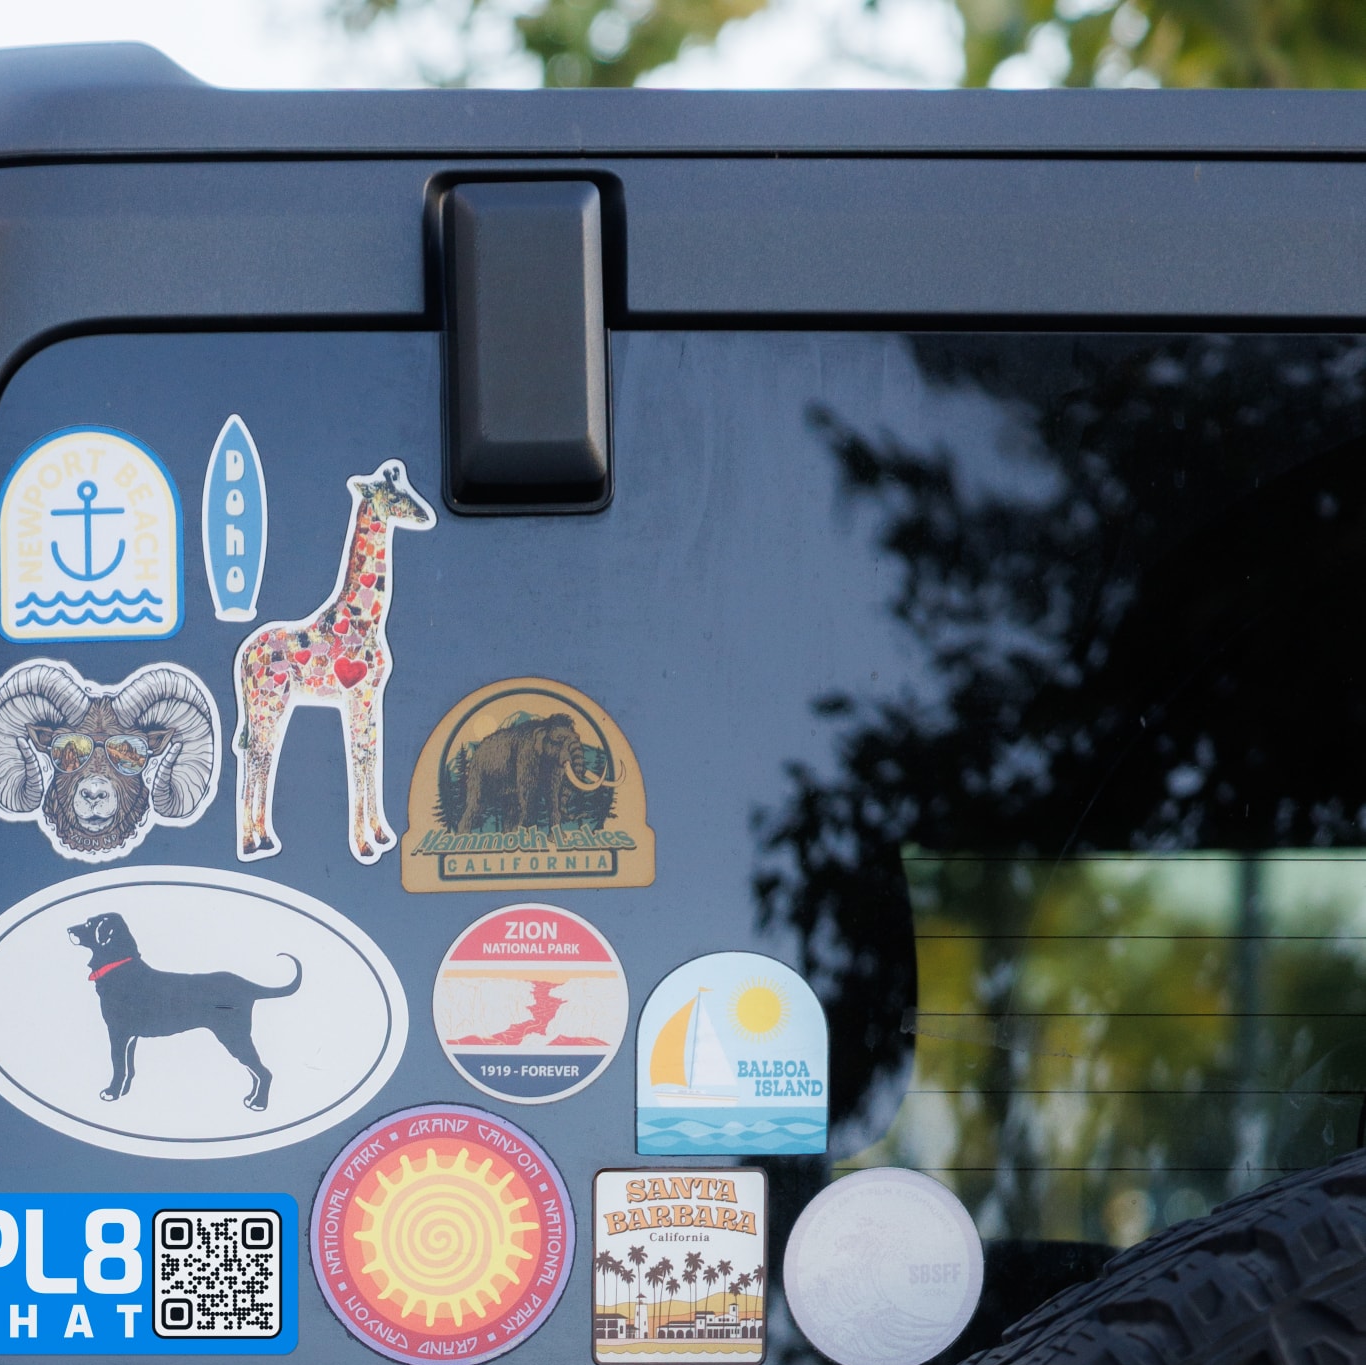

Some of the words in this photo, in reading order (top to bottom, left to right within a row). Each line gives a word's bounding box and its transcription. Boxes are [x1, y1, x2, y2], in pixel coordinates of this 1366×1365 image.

[18, 448, 107, 583] NEWPORT
[113, 461, 160, 582] BEACH
[70, 833, 100, 847] ZION
[411, 824, 550, 856] Mammoth
[551, 823, 637, 851] Lakes
[447, 854, 609, 873] CALIFORNIA
[504, 921, 558, 940] ZION
[482, 943, 545, 954] NATIONAL
[548, 943, 580, 955] PARK
[480, 1065, 512, 1077] 1919
[521, 1065, 580, 1077] FOREVER
[737, 1060, 810, 1078] BALBOA
[755, 1079, 824, 1097] ISLAND
[408, 1118, 470, 1138] GRAND
[478, 1124, 542, 1179] CANYON
[625, 1176, 739, 1204] SANTA
[324, 1186, 349, 1276] NATIONAL
[343, 1139, 385, 1181] PARK
[603, 1204, 758, 1236] BARBARA
[536, 1198, 563, 1288] NATIONAL
[649, 1232, 711, 1242] California
[908, 1263, 962, 1285] SBSFF
[345, 1295, 409, 1350] CANYON
[500, 1293, 543, 1335] PARK
[417, 1336, 479, 1356] GRAND
